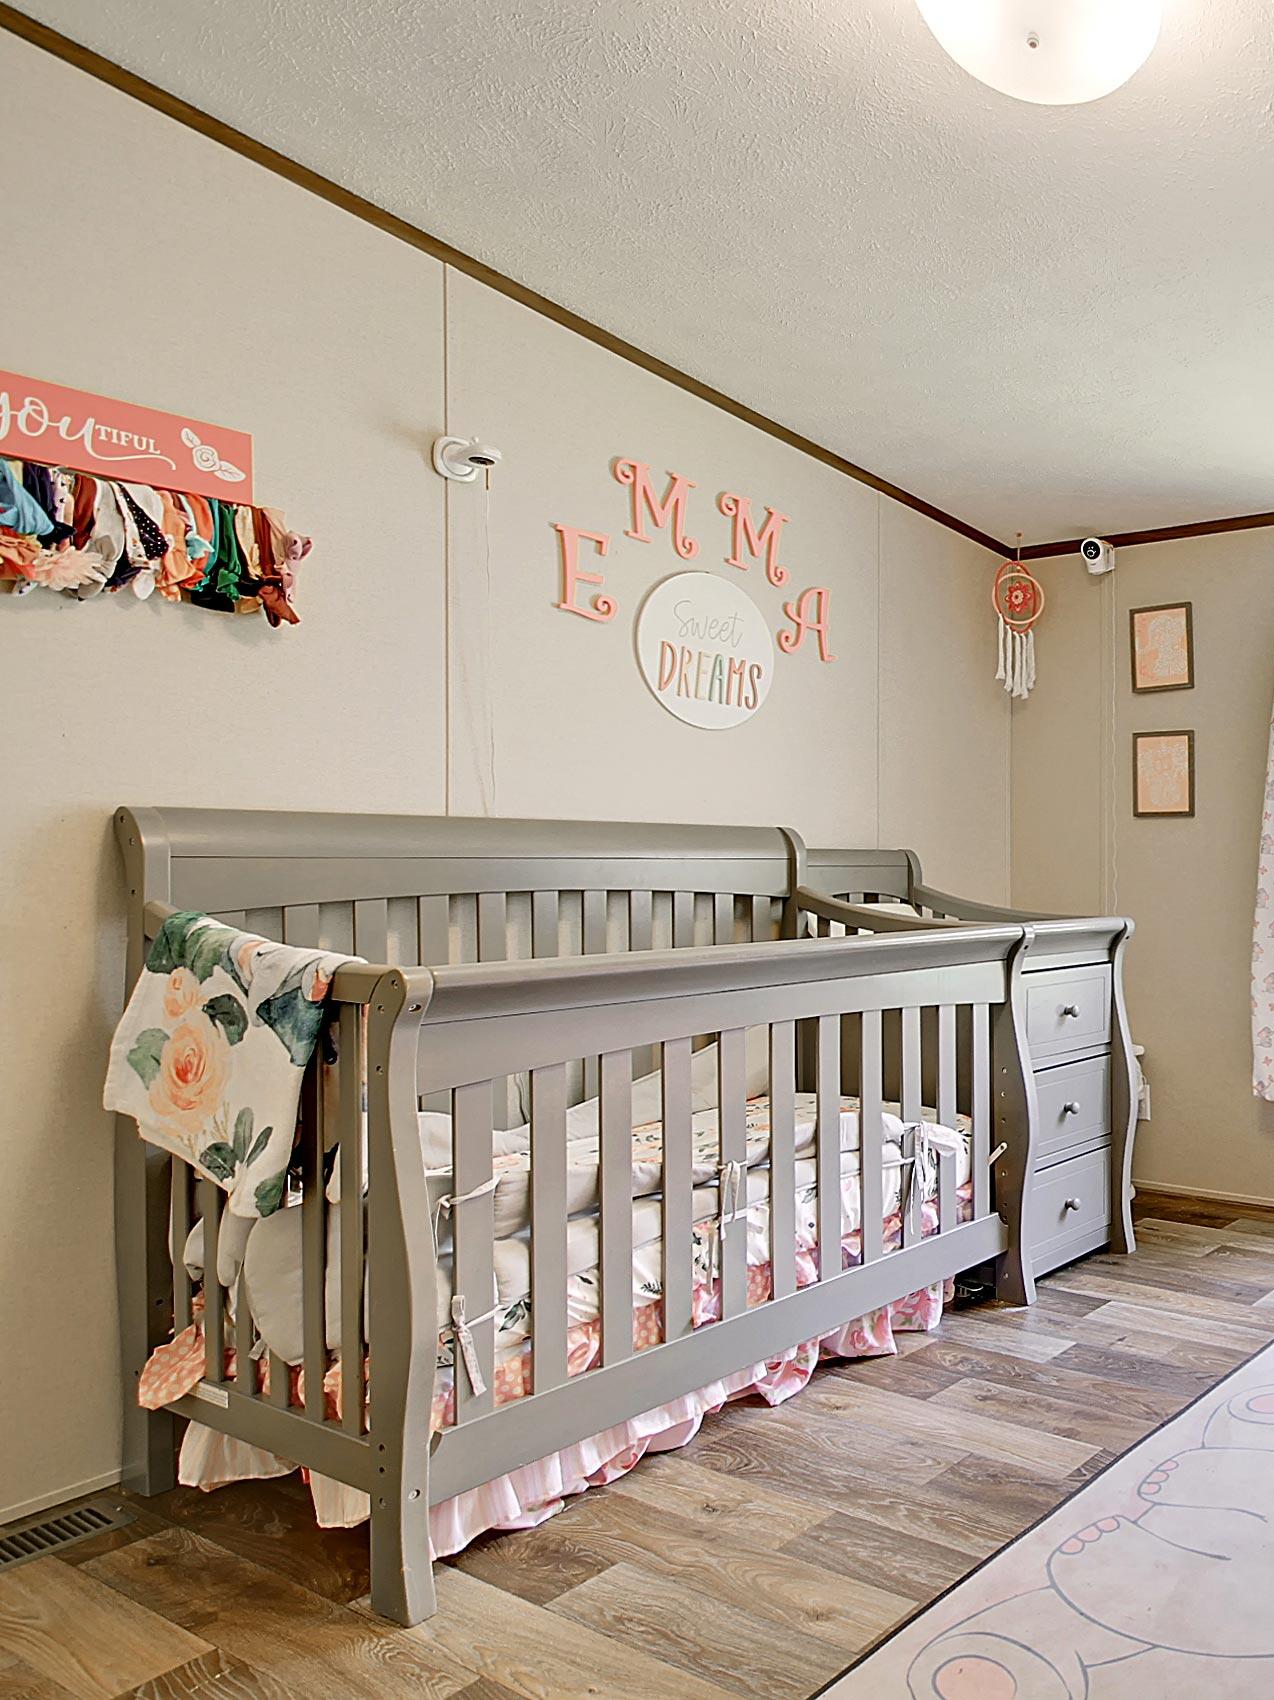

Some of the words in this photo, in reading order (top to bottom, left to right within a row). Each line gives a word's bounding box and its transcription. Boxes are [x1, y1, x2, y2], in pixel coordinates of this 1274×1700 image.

[553, 458, 837, 662] EMMA
[673, 599, 745, 649] Sweet
[658, 640, 763, 711] DREAMS
